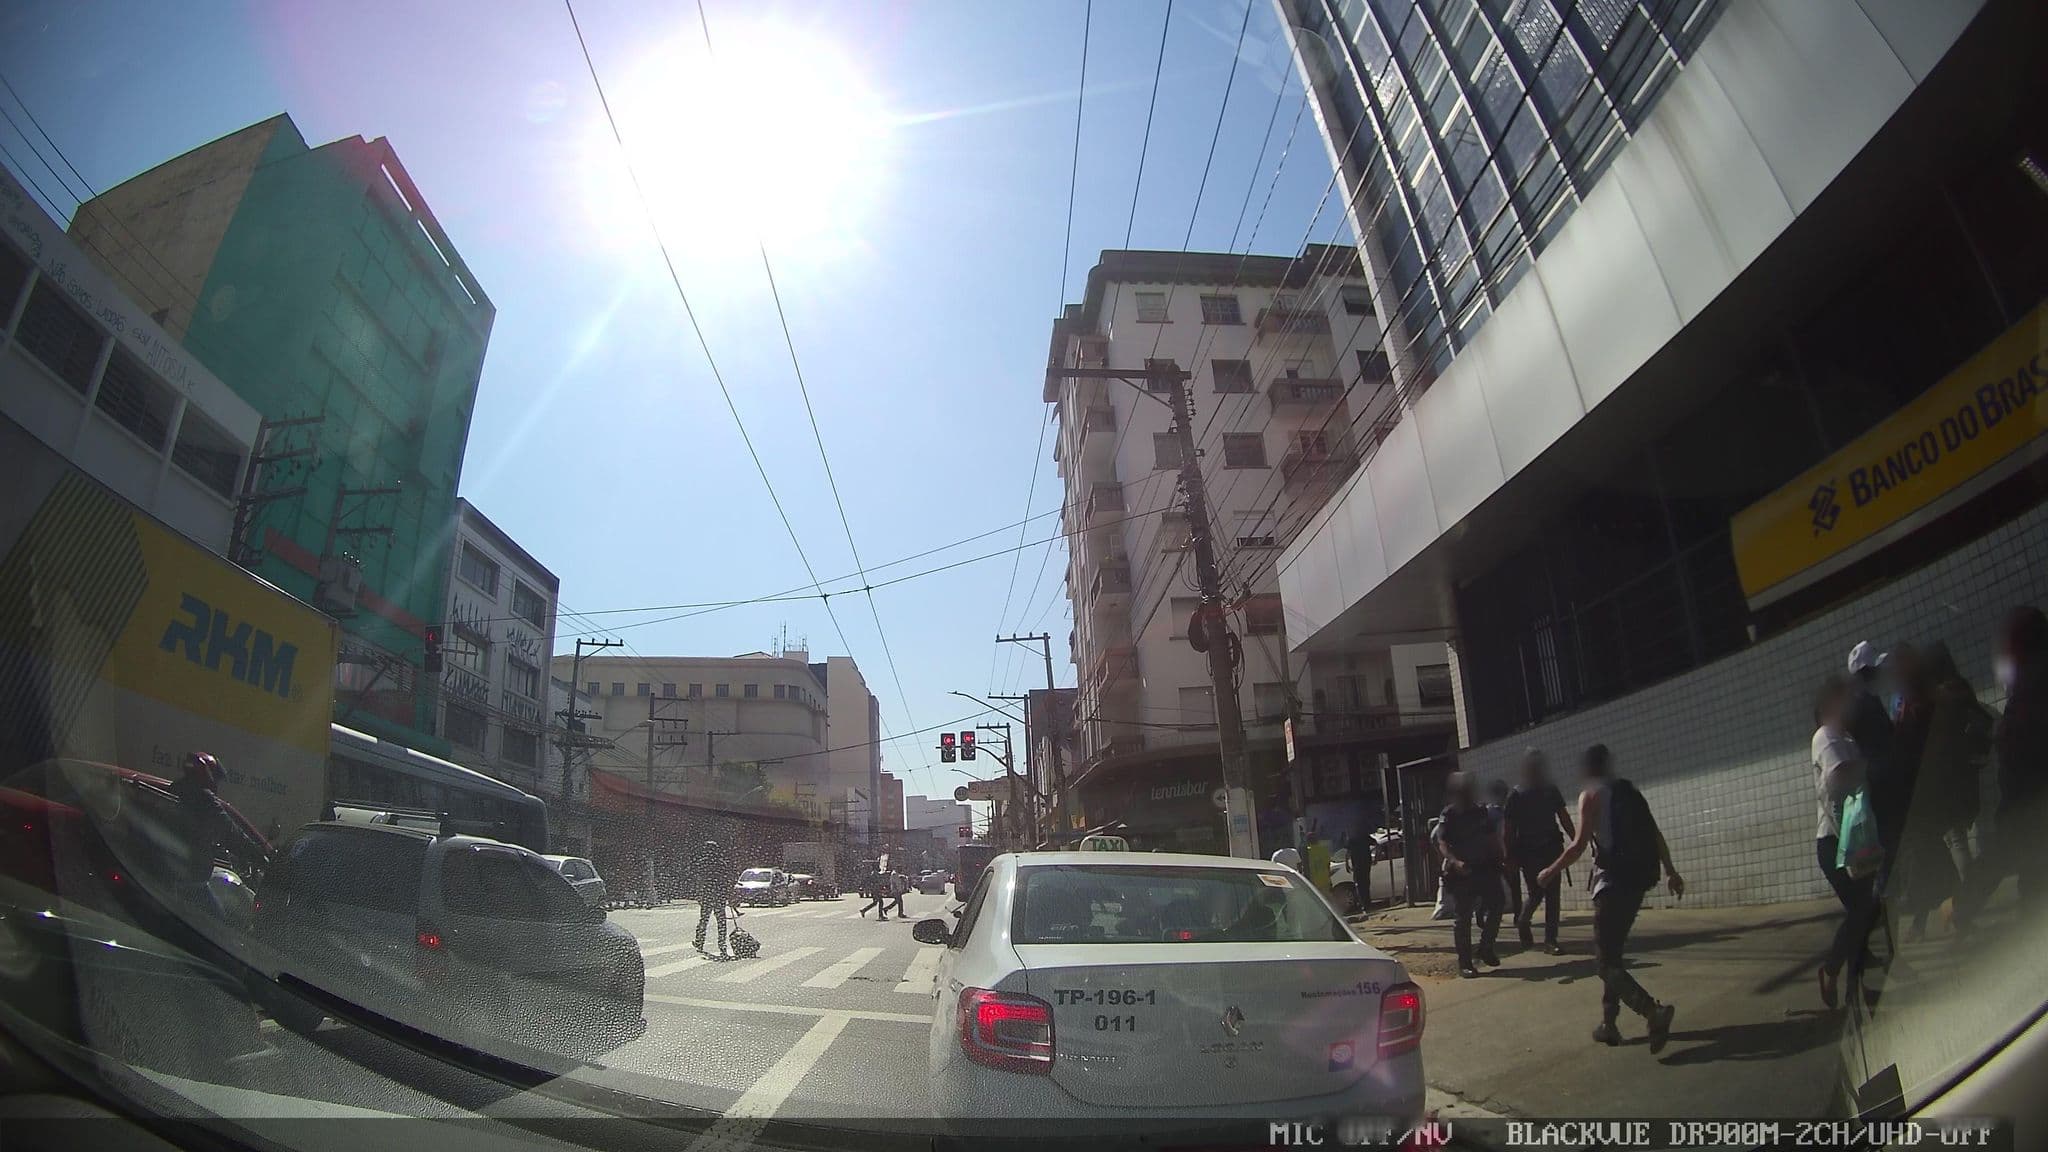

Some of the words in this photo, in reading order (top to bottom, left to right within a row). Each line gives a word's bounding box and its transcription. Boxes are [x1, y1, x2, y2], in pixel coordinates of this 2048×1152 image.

[1849, 431, 1940, 507] BANCO
[1940, 404, 1980, 453] DO
[160, 592, 298, 698] RKM
[1151, 779, 1208, 800] tennisbar
[1090, 838, 1124, 851] TAXI
[1357, 981, 1381, 994] 156
[1054, 989, 1155, 1005] TP-196-1
[1094, 1015, 1135, 1032] 011
